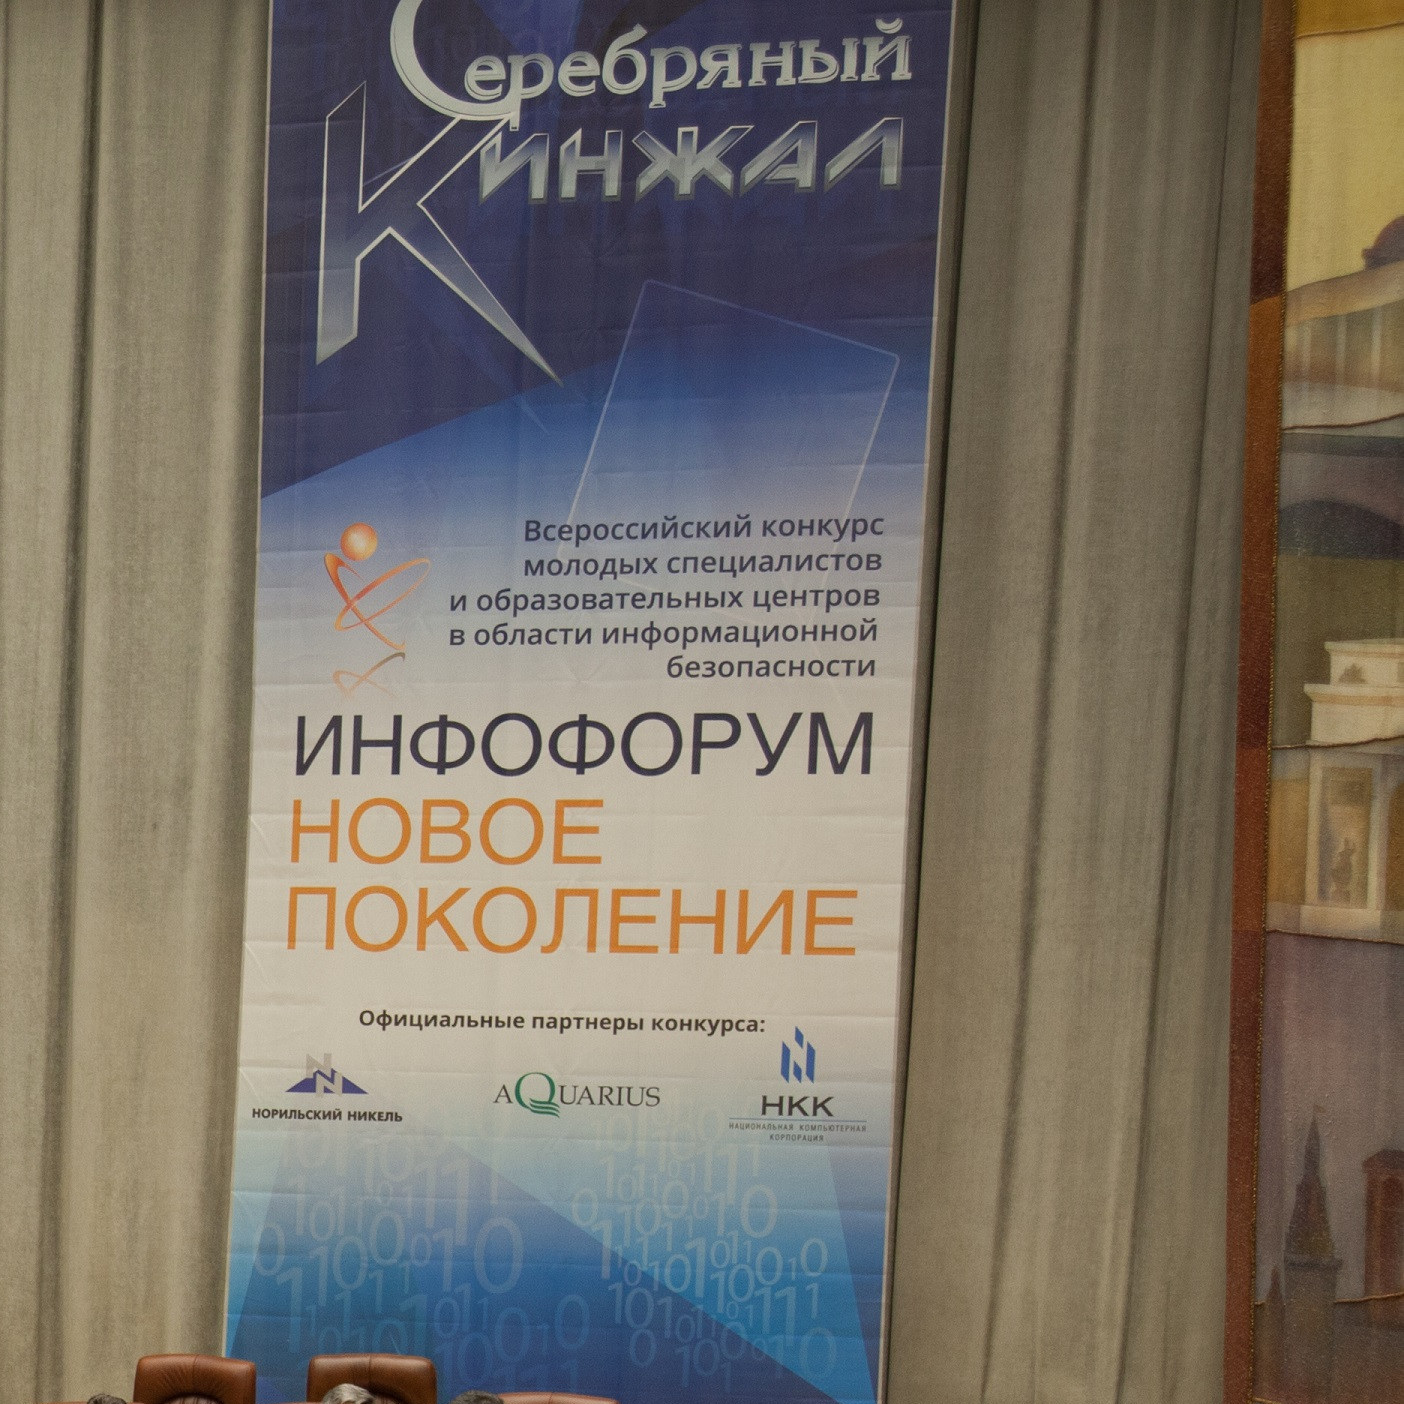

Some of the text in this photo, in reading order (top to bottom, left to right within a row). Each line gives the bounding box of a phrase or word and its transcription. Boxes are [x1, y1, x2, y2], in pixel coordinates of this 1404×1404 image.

[390, 0, 912, 130] Серебряный
[523, 514, 884, 545] Всероссийский конкурс
[523, 549, 883, 581] молодых специалистов
[449, 584, 880, 614] и образовательных центров
[449, 616, 877, 653] в области информационной
[667, 653, 876, 680] безопасности
[295, 710, 874, 777] ИНФОФОРУМ
[291, 796, 605, 865] НОВОЕ
[286, 885, 859, 956] ПОКОЛЕНИЕ
[359, 1007, 766, 1037] Официальные партнеры конкурса:
[494, 1071, 661, 1118] AQUARIUS
[761, 1095, 834, 1117] НКК
[252, 1106, 402, 1123] НОРИЛЬСКИЙ НИКЕЛЬ
[729, 1122, 867, 1132] НАЦИОНАЛЬНАЯ КОМПЬЮТЕРНАЯ
[770, 1134, 824, 1142] КОРПОРАЦИЯ
